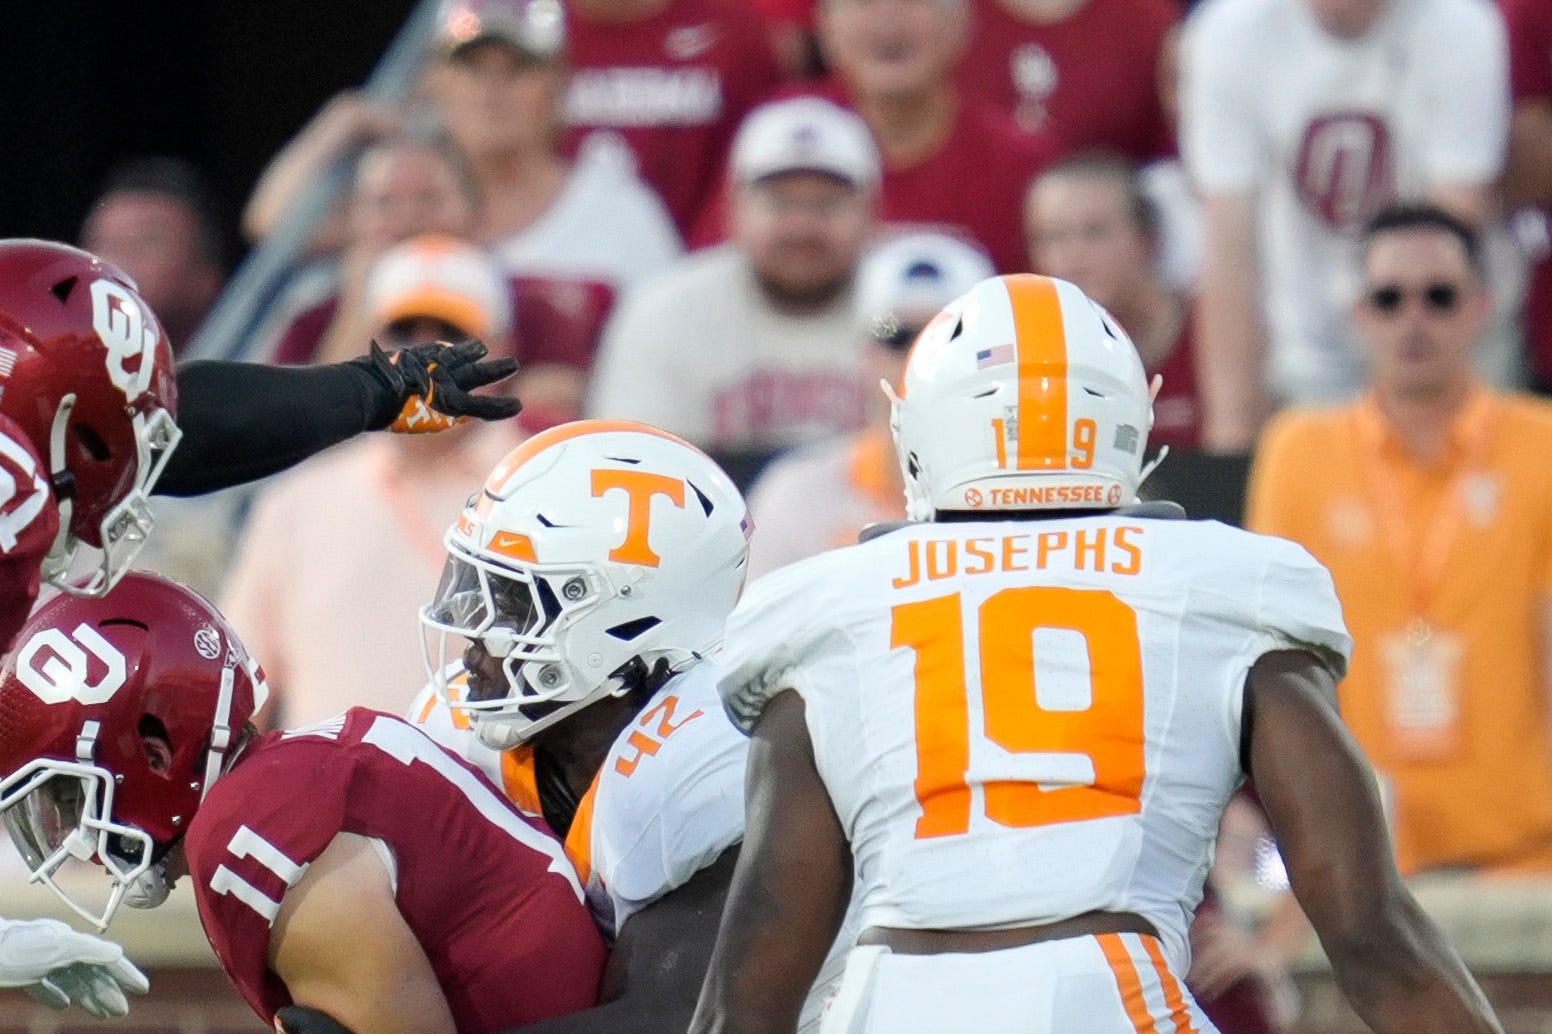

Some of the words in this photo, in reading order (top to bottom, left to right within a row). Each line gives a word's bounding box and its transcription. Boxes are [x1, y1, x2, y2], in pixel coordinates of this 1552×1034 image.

[590, 468, 686, 568] T
[989, 485, 1104, 506] TENNESSEE
[891, 525, 1145, 589] JOSEPHS
[16, 622, 127, 705] OU
[615, 695, 704, 778] 42
[889, 586, 1146, 840] 19
[209, 824, 310, 929] 11
